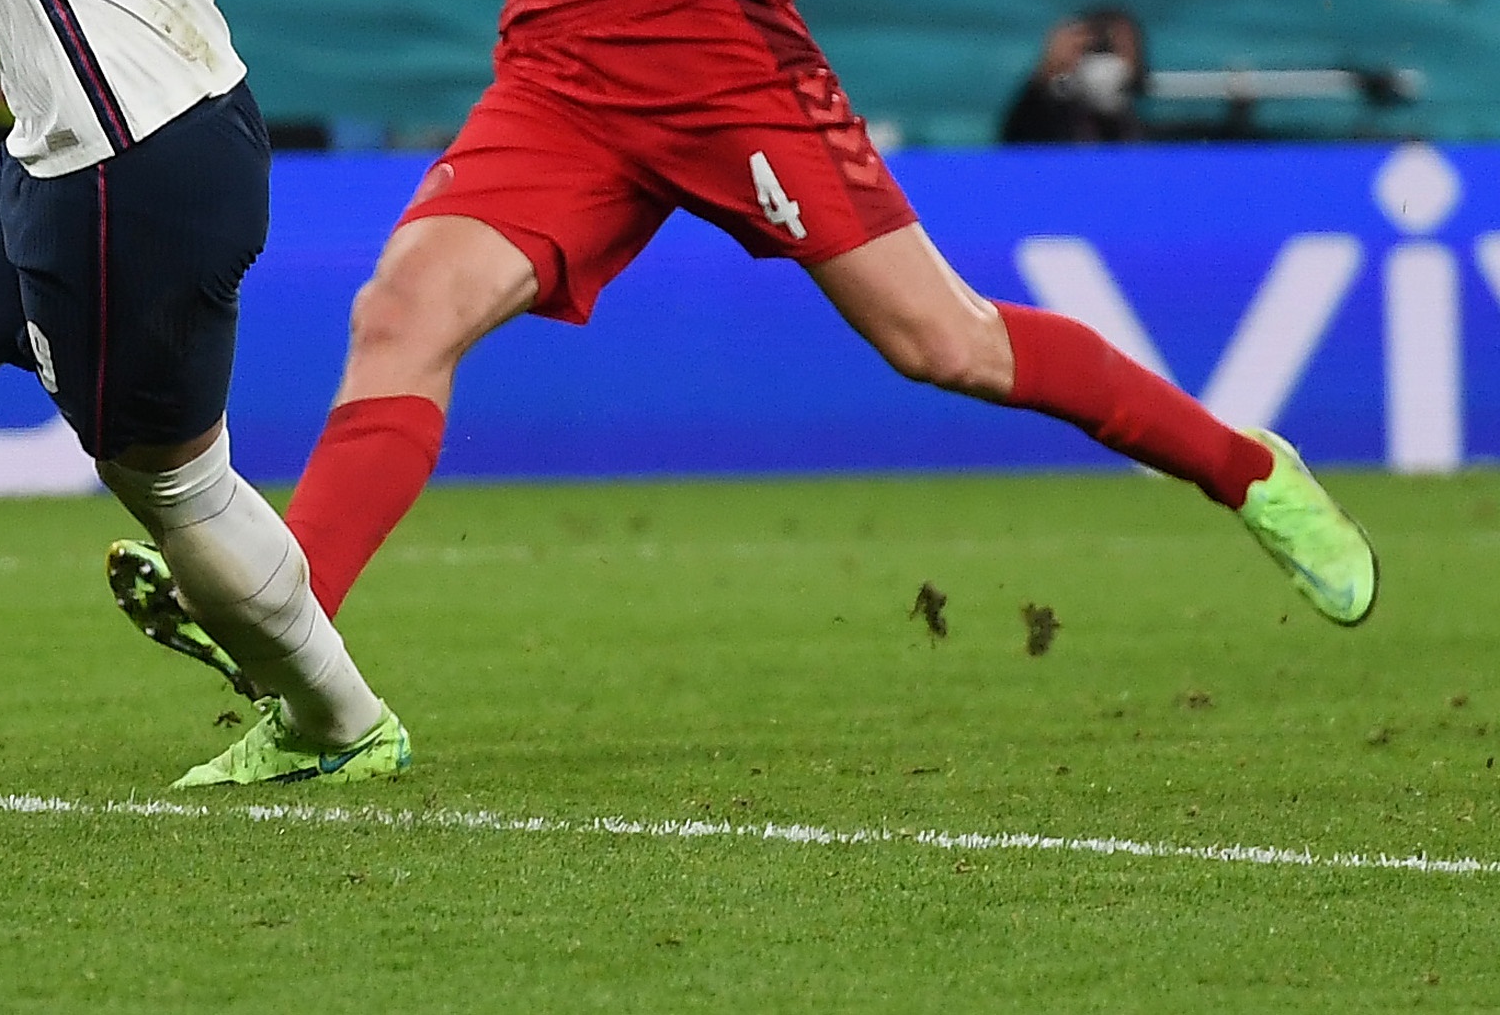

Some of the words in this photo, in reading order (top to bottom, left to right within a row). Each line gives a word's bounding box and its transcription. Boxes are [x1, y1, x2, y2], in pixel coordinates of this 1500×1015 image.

[750, 149, 808, 240] 4
[1014, 143, 1500, 473] vi
[26, 319, 59, 394] 9
